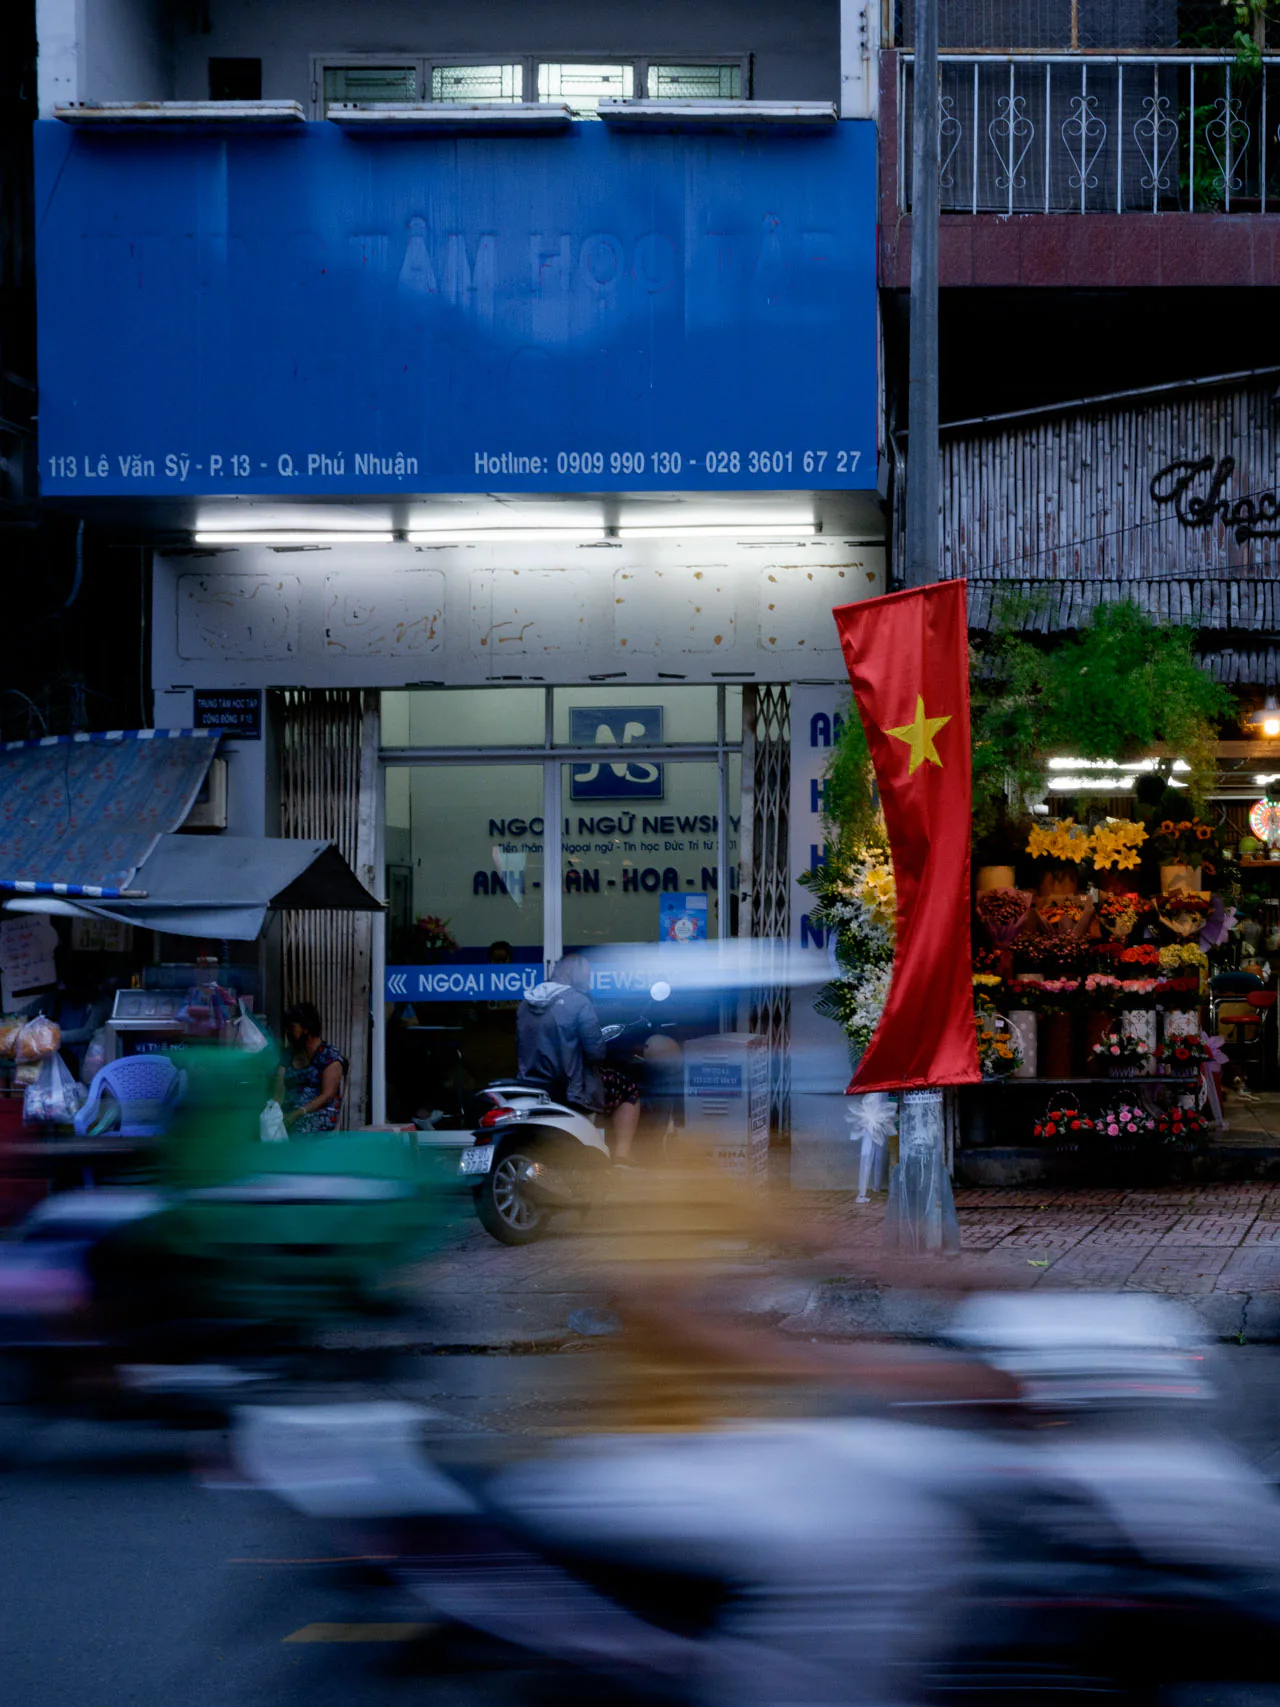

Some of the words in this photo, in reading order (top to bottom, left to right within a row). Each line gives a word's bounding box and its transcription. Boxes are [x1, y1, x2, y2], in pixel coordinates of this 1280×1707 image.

[48, 454, 77, 478] 113
[83, 452, 110, 478] Lê
[118, 453, 156, 477] Văn
[164, 450, 191, 483] Sỹ
[209, 454, 225, 477] P.
[228, 454, 251, 477] 13
[277, 453, 299, 478] Q.
[307, 450, 345, 477] Phú
[354, 451, 419, 481] Nhuận
[556, 451, 604, 475] 0909
[609, 451, 645, 474] 990
[650, 451, 681, 474] 130
[705, 450, 741, 474] 028
[748, 450, 794, 474] 3601
[802, 450, 827, 473] 67
[836, 449, 862, 473] 27
[488, 816, 570, 837] NGOI
[578, 811, 636, 835] NGỮ
[473, 869, 526, 895] ANH
[562, 858, 600, 893] ÀN
[622, 866, 679, 892] HOA
[418, 973, 484, 996] NGOẠI
[490, 967, 537, 992] NGỮ
